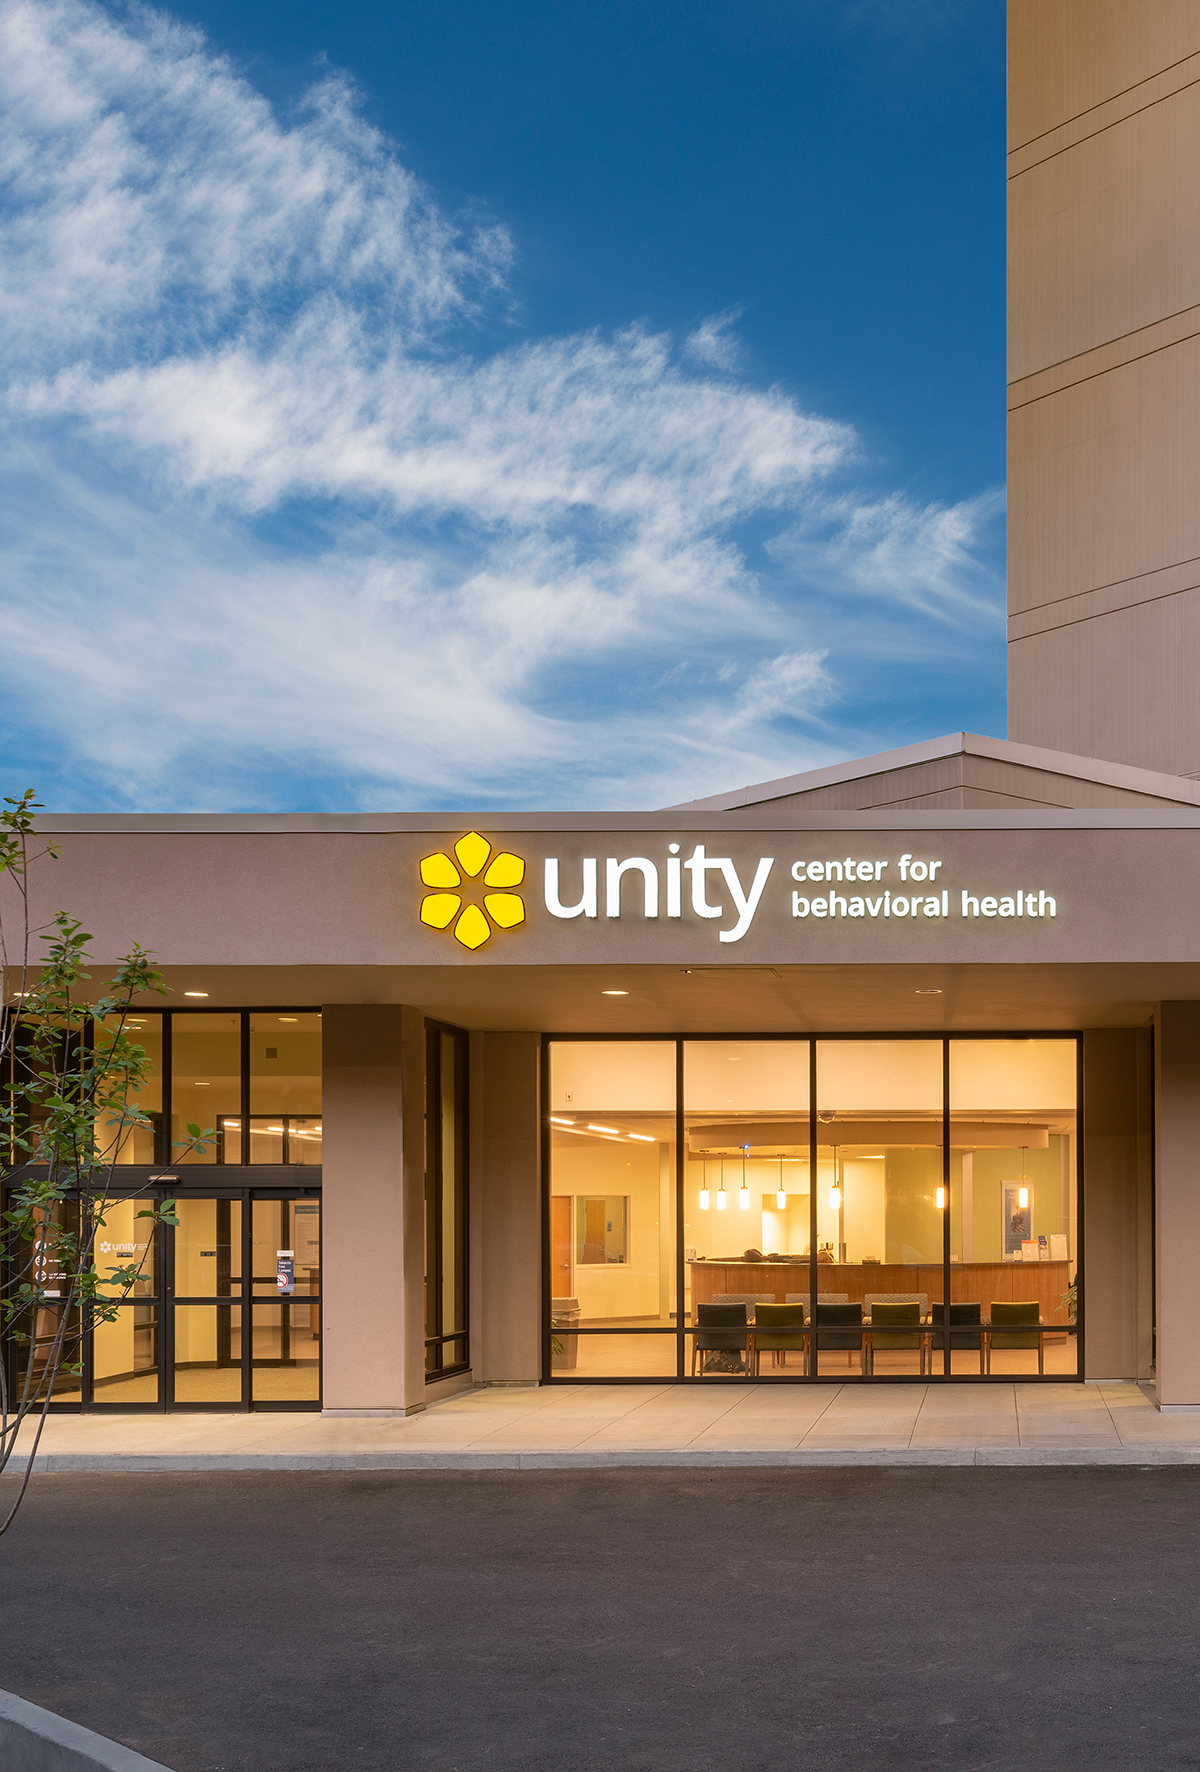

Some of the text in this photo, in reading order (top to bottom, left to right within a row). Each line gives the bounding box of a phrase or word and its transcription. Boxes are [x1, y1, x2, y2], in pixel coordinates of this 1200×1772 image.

[791, 854, 942, 882] center for
[544, 843, 775, 943] unity
[792, 890, 1057, 918] behavioral health
[112, 1241, 137, 1253] unity
